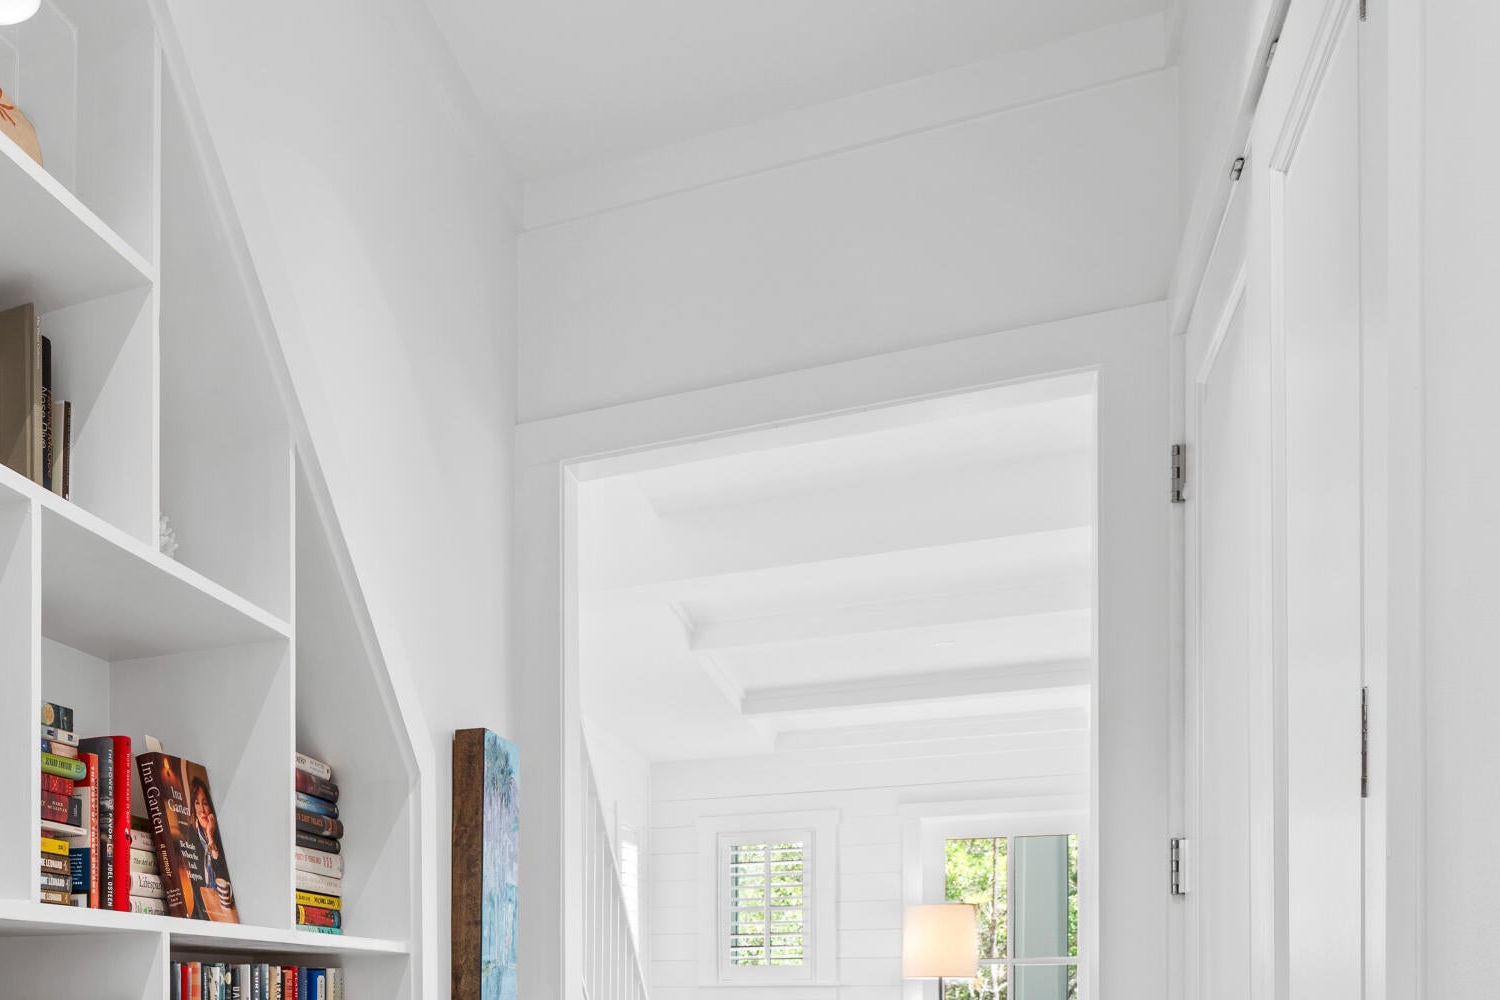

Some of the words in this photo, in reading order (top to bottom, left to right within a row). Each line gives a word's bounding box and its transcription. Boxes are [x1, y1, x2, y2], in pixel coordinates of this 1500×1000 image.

[142, 761, 154, 784] Ina
[146, 785, 164, 834] Garten
[161, 850, 174, 878] memoir
